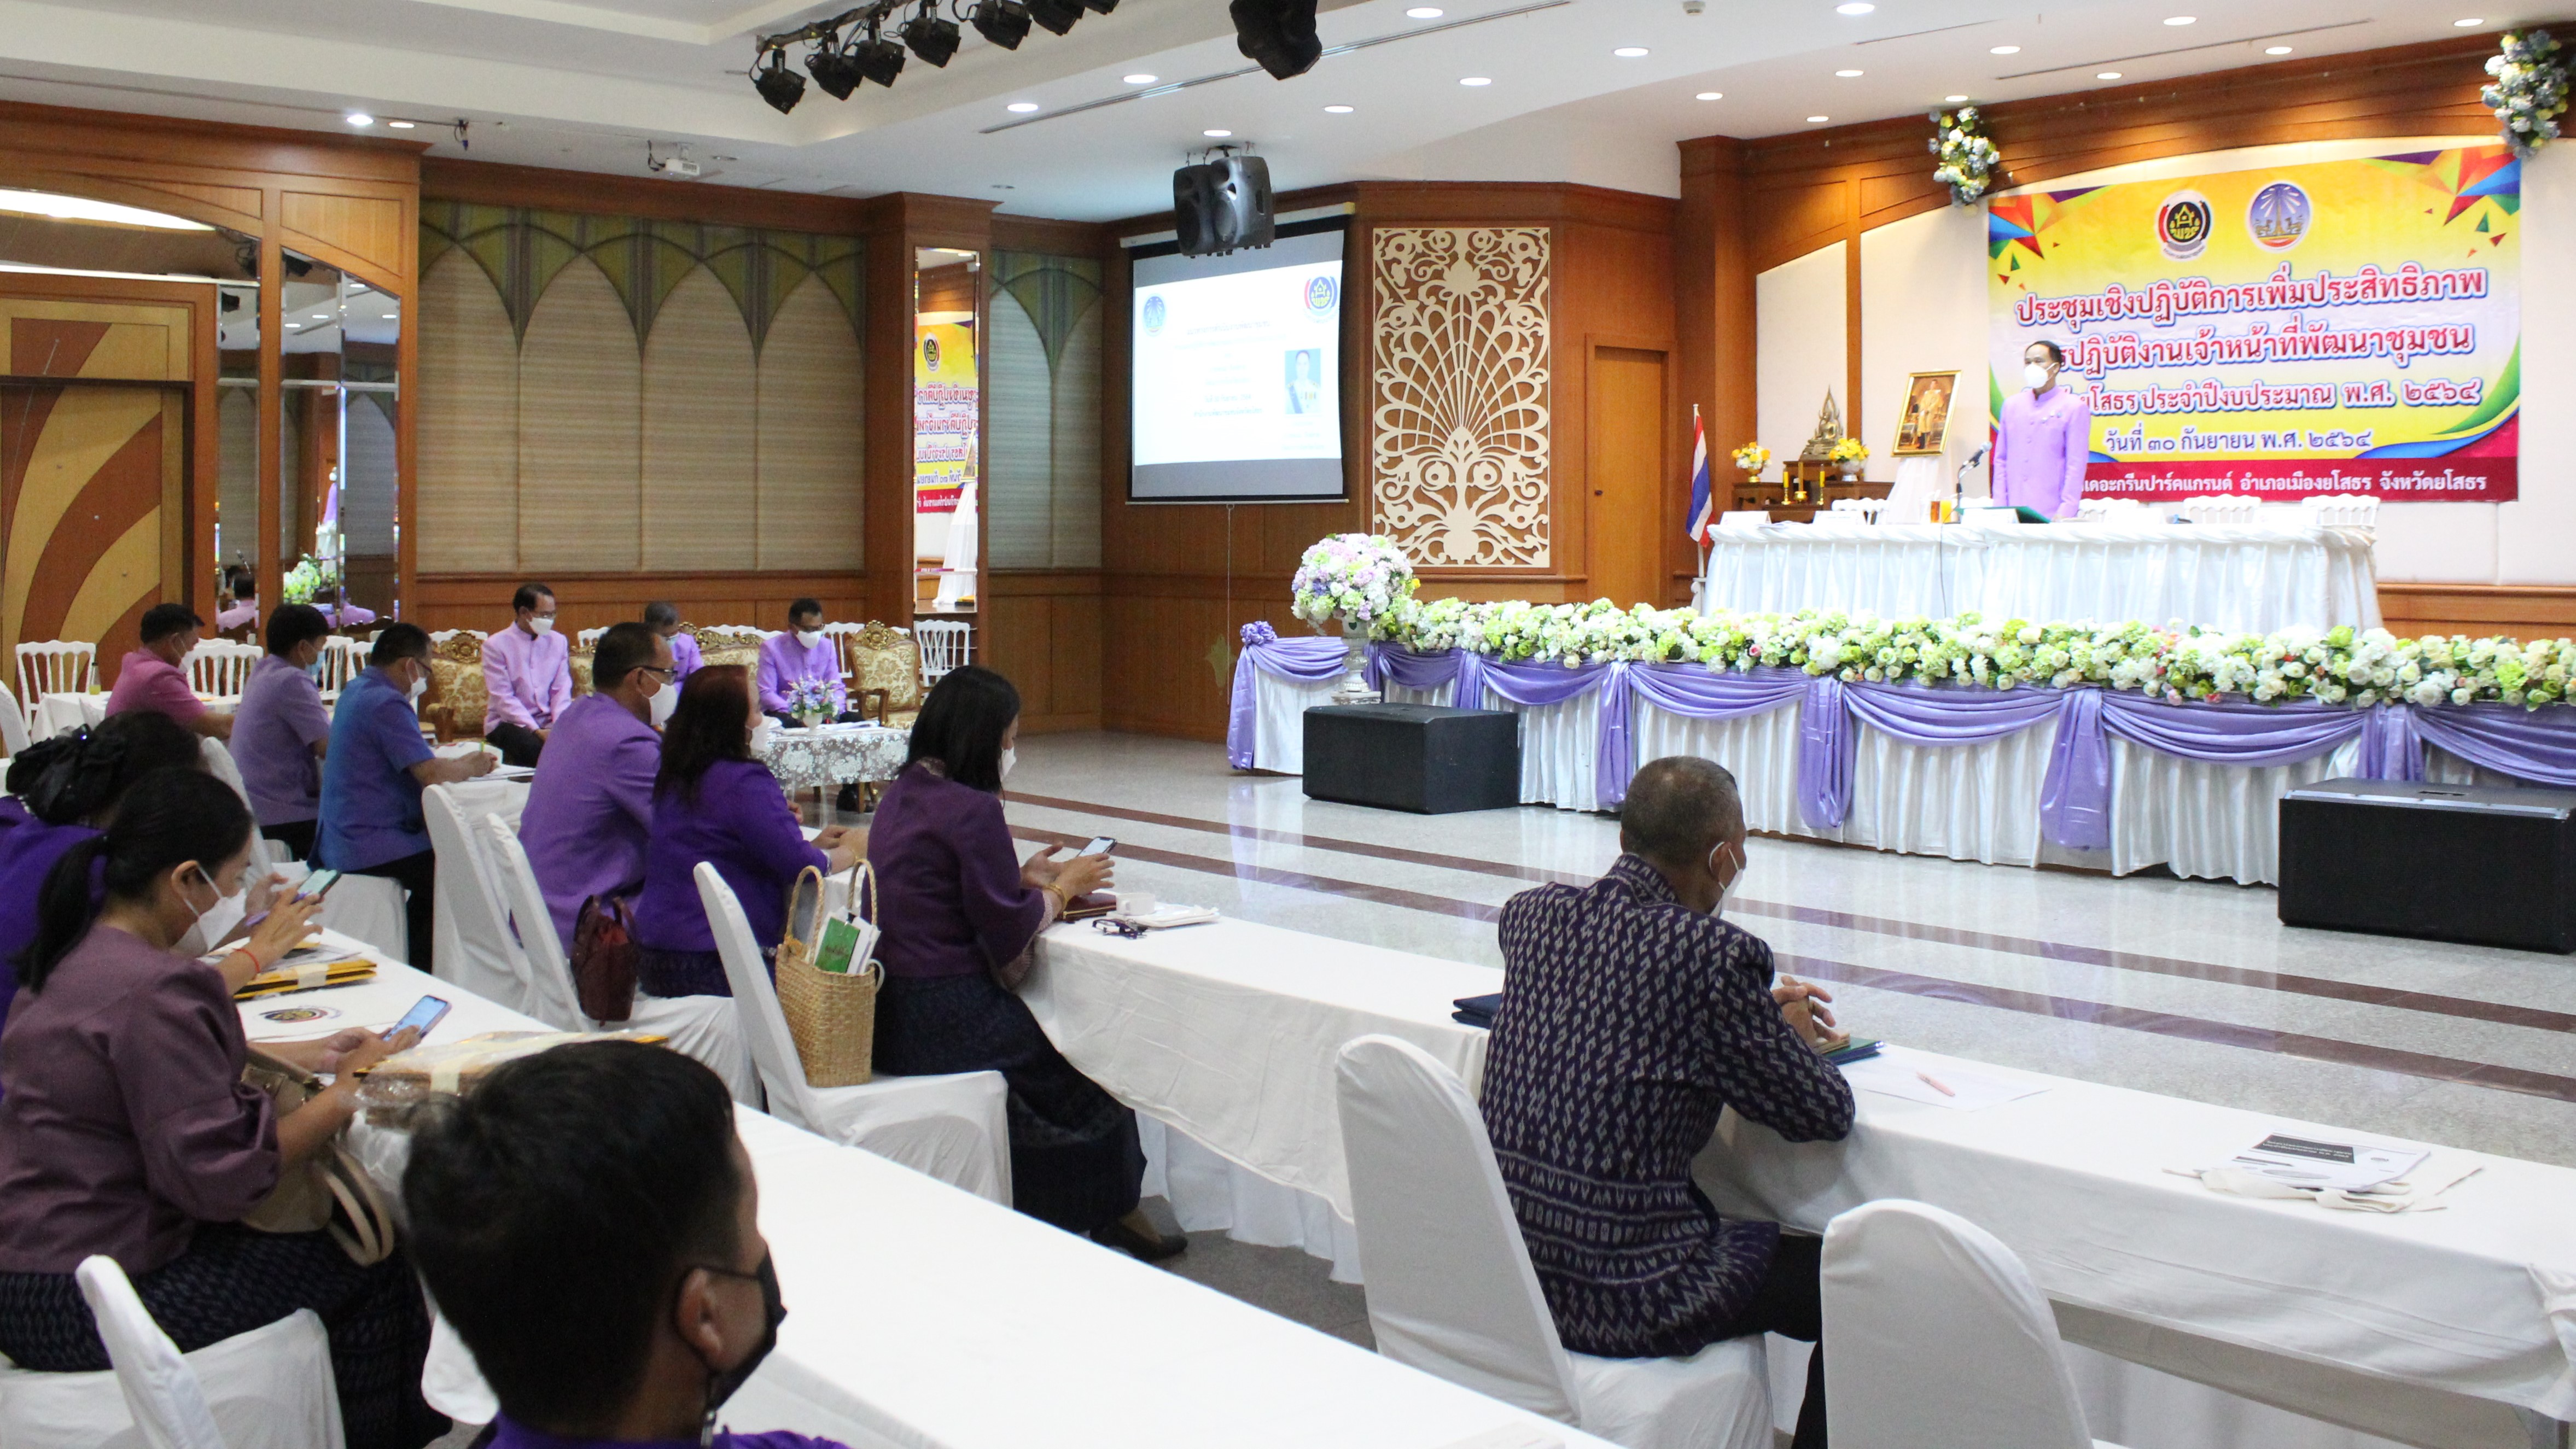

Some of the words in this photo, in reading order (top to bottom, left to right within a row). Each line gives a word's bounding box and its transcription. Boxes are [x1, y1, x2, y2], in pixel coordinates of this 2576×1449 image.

[2016, 265, 2483, 328] ประชุมเชิงปฏิบัติการเพิ่มประสิทธิภาพ
[2142, 381, 2332, 409] ประจำปีงบประมาณ
[2345, 382, 2392, 403] พ.ศ.
[2404, 379, 2478, 401] ๒๕๖๔
[2106, 423, 2142, 451] วันที่
[2148, 438, 2175, 451] ๓๐
[2181, 428, 2254, 450] กันยายน
[2262, 433, 2302, 448] พ.ศ.
[2309, 431, 2372, 447] ๒๕๖๔
[2082, 472, 2233, 492] เดอะกรีนปาร์คแกรนด์
[2240, 469, 2372, 490] อำเภอเมืองยโสธร
[2380, 469, 2487, 490] จังหวัดยโสธร
